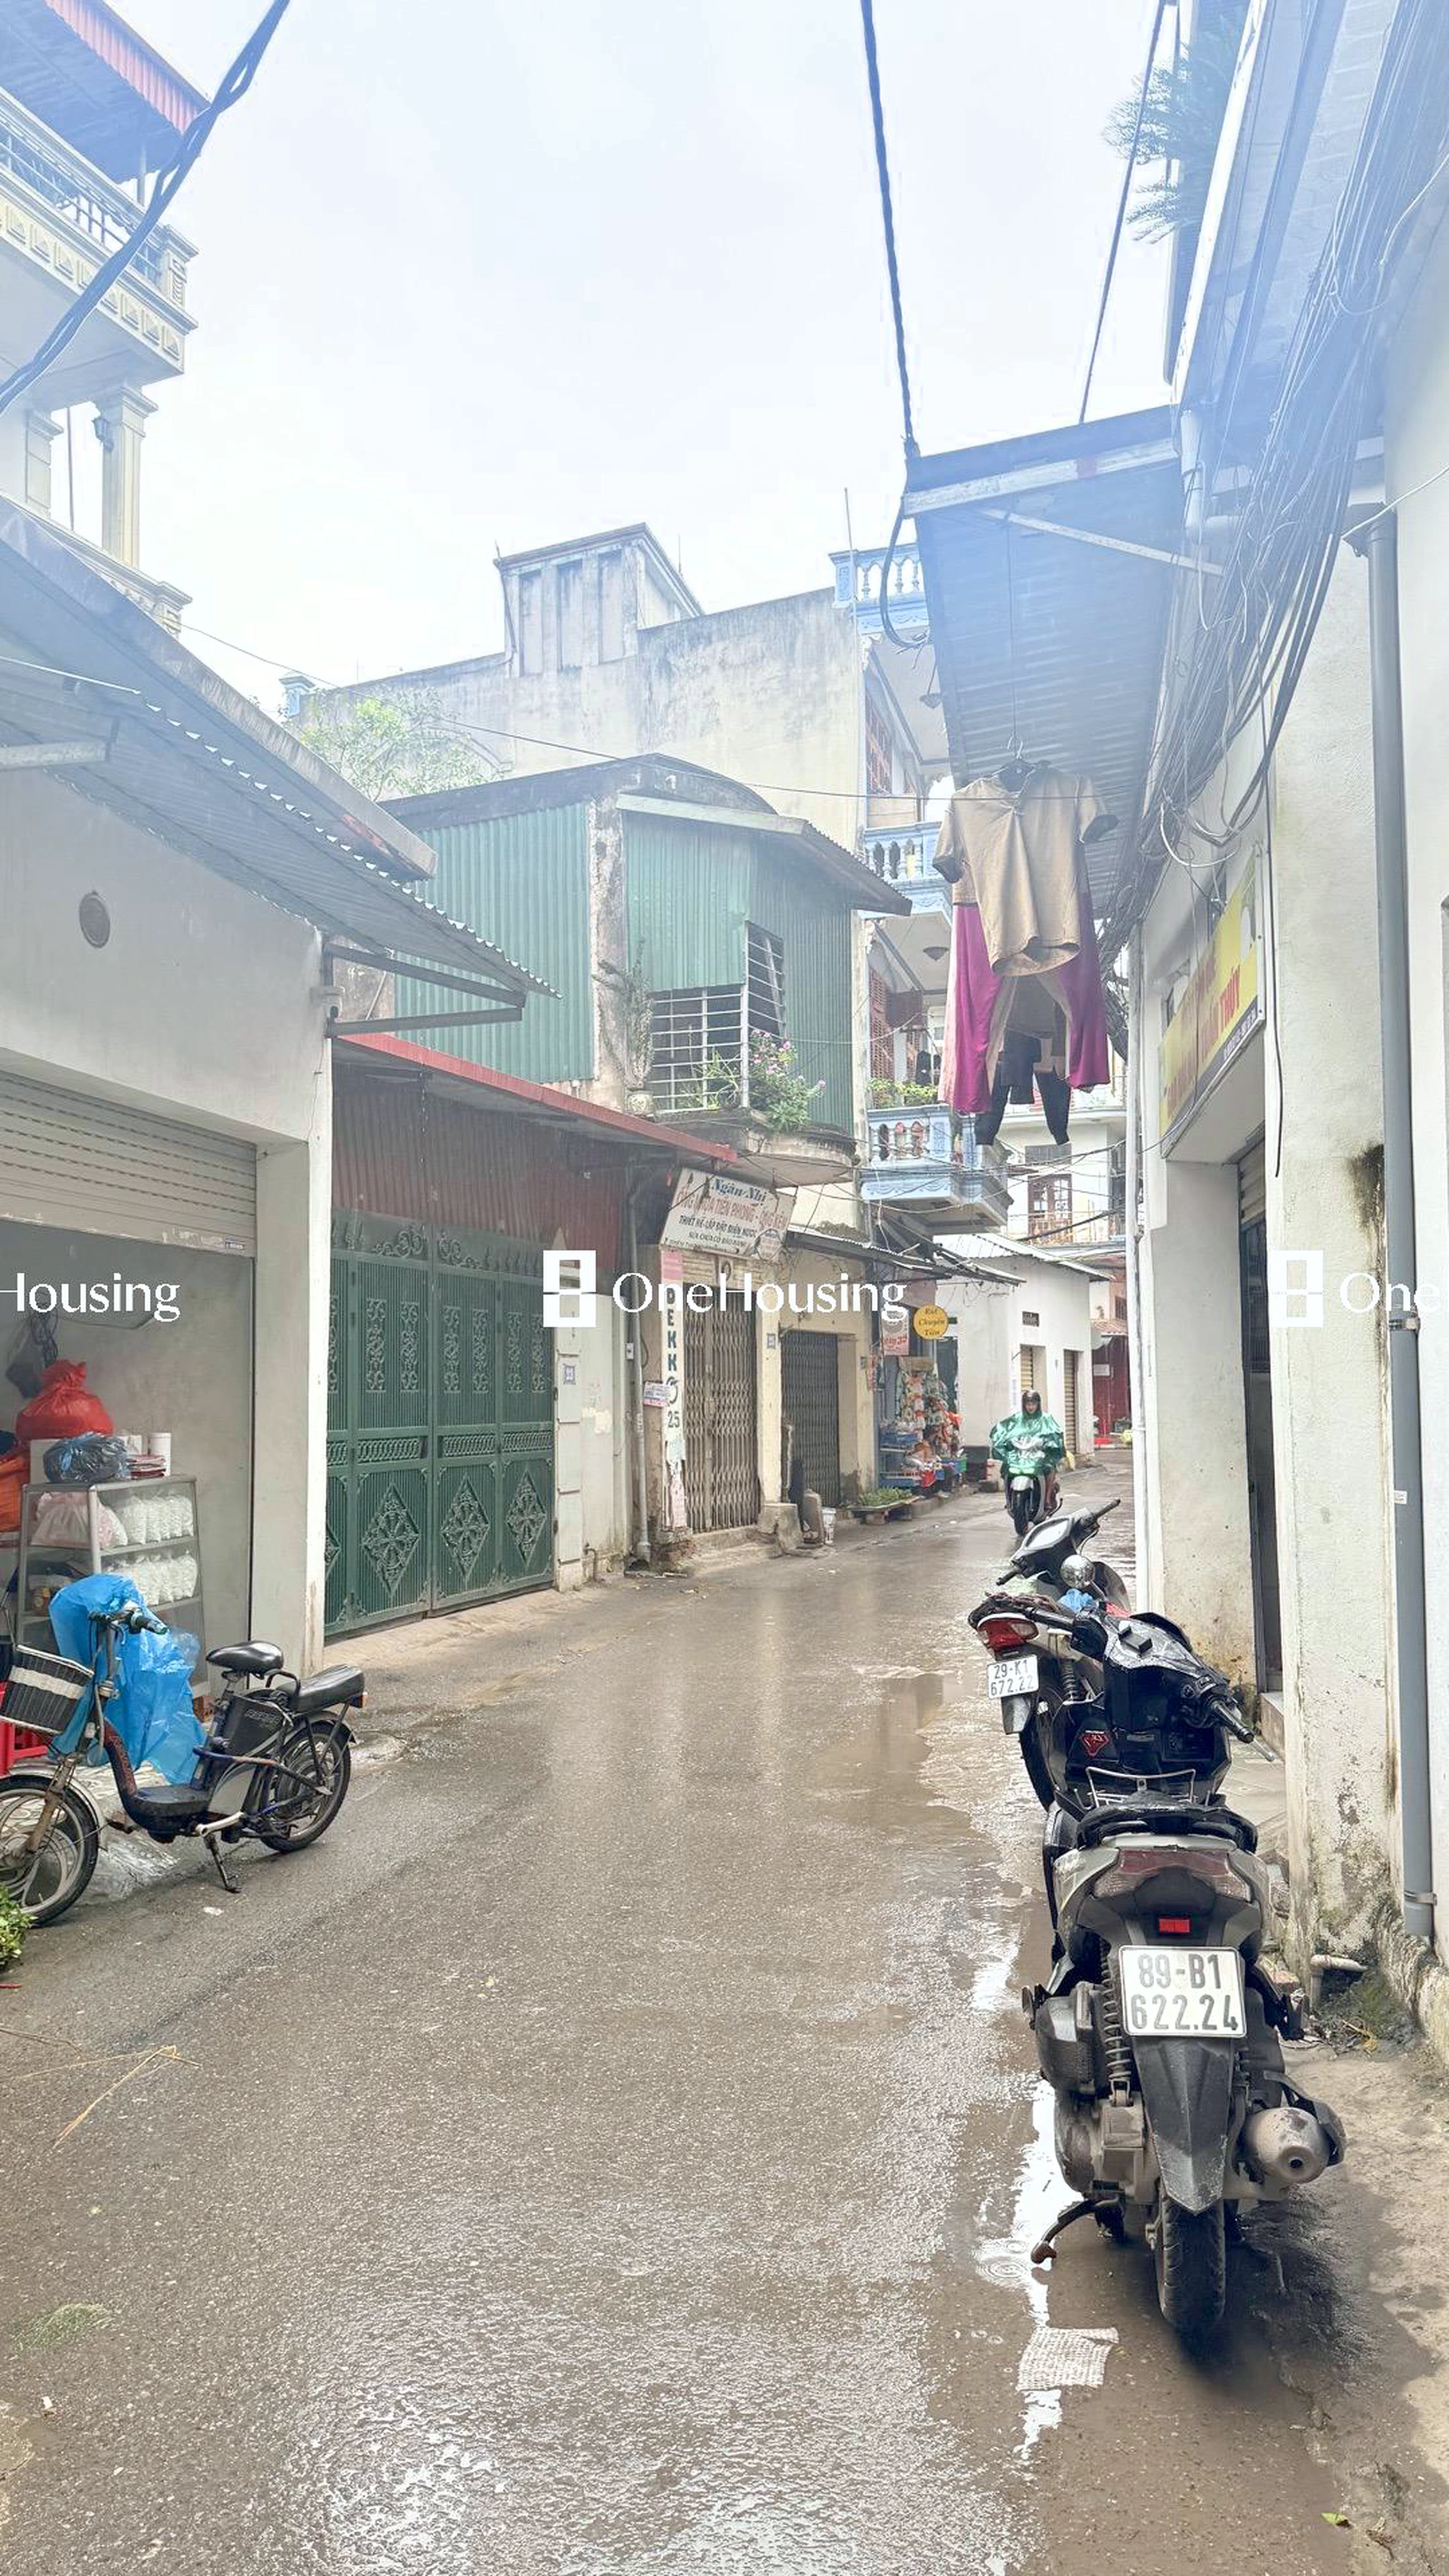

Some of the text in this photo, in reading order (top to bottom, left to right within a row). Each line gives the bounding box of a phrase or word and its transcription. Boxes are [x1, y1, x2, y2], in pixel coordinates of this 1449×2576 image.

[668, 1410, 680, 1429] 25
[994, 1659, 1028, 1679] 29-K1
[990, 1675, 1034, 1696] 672.22
[1137, 1953, 1221, 1989] 89-B1
[1131, 1994, 1239, 2031] 622.24
